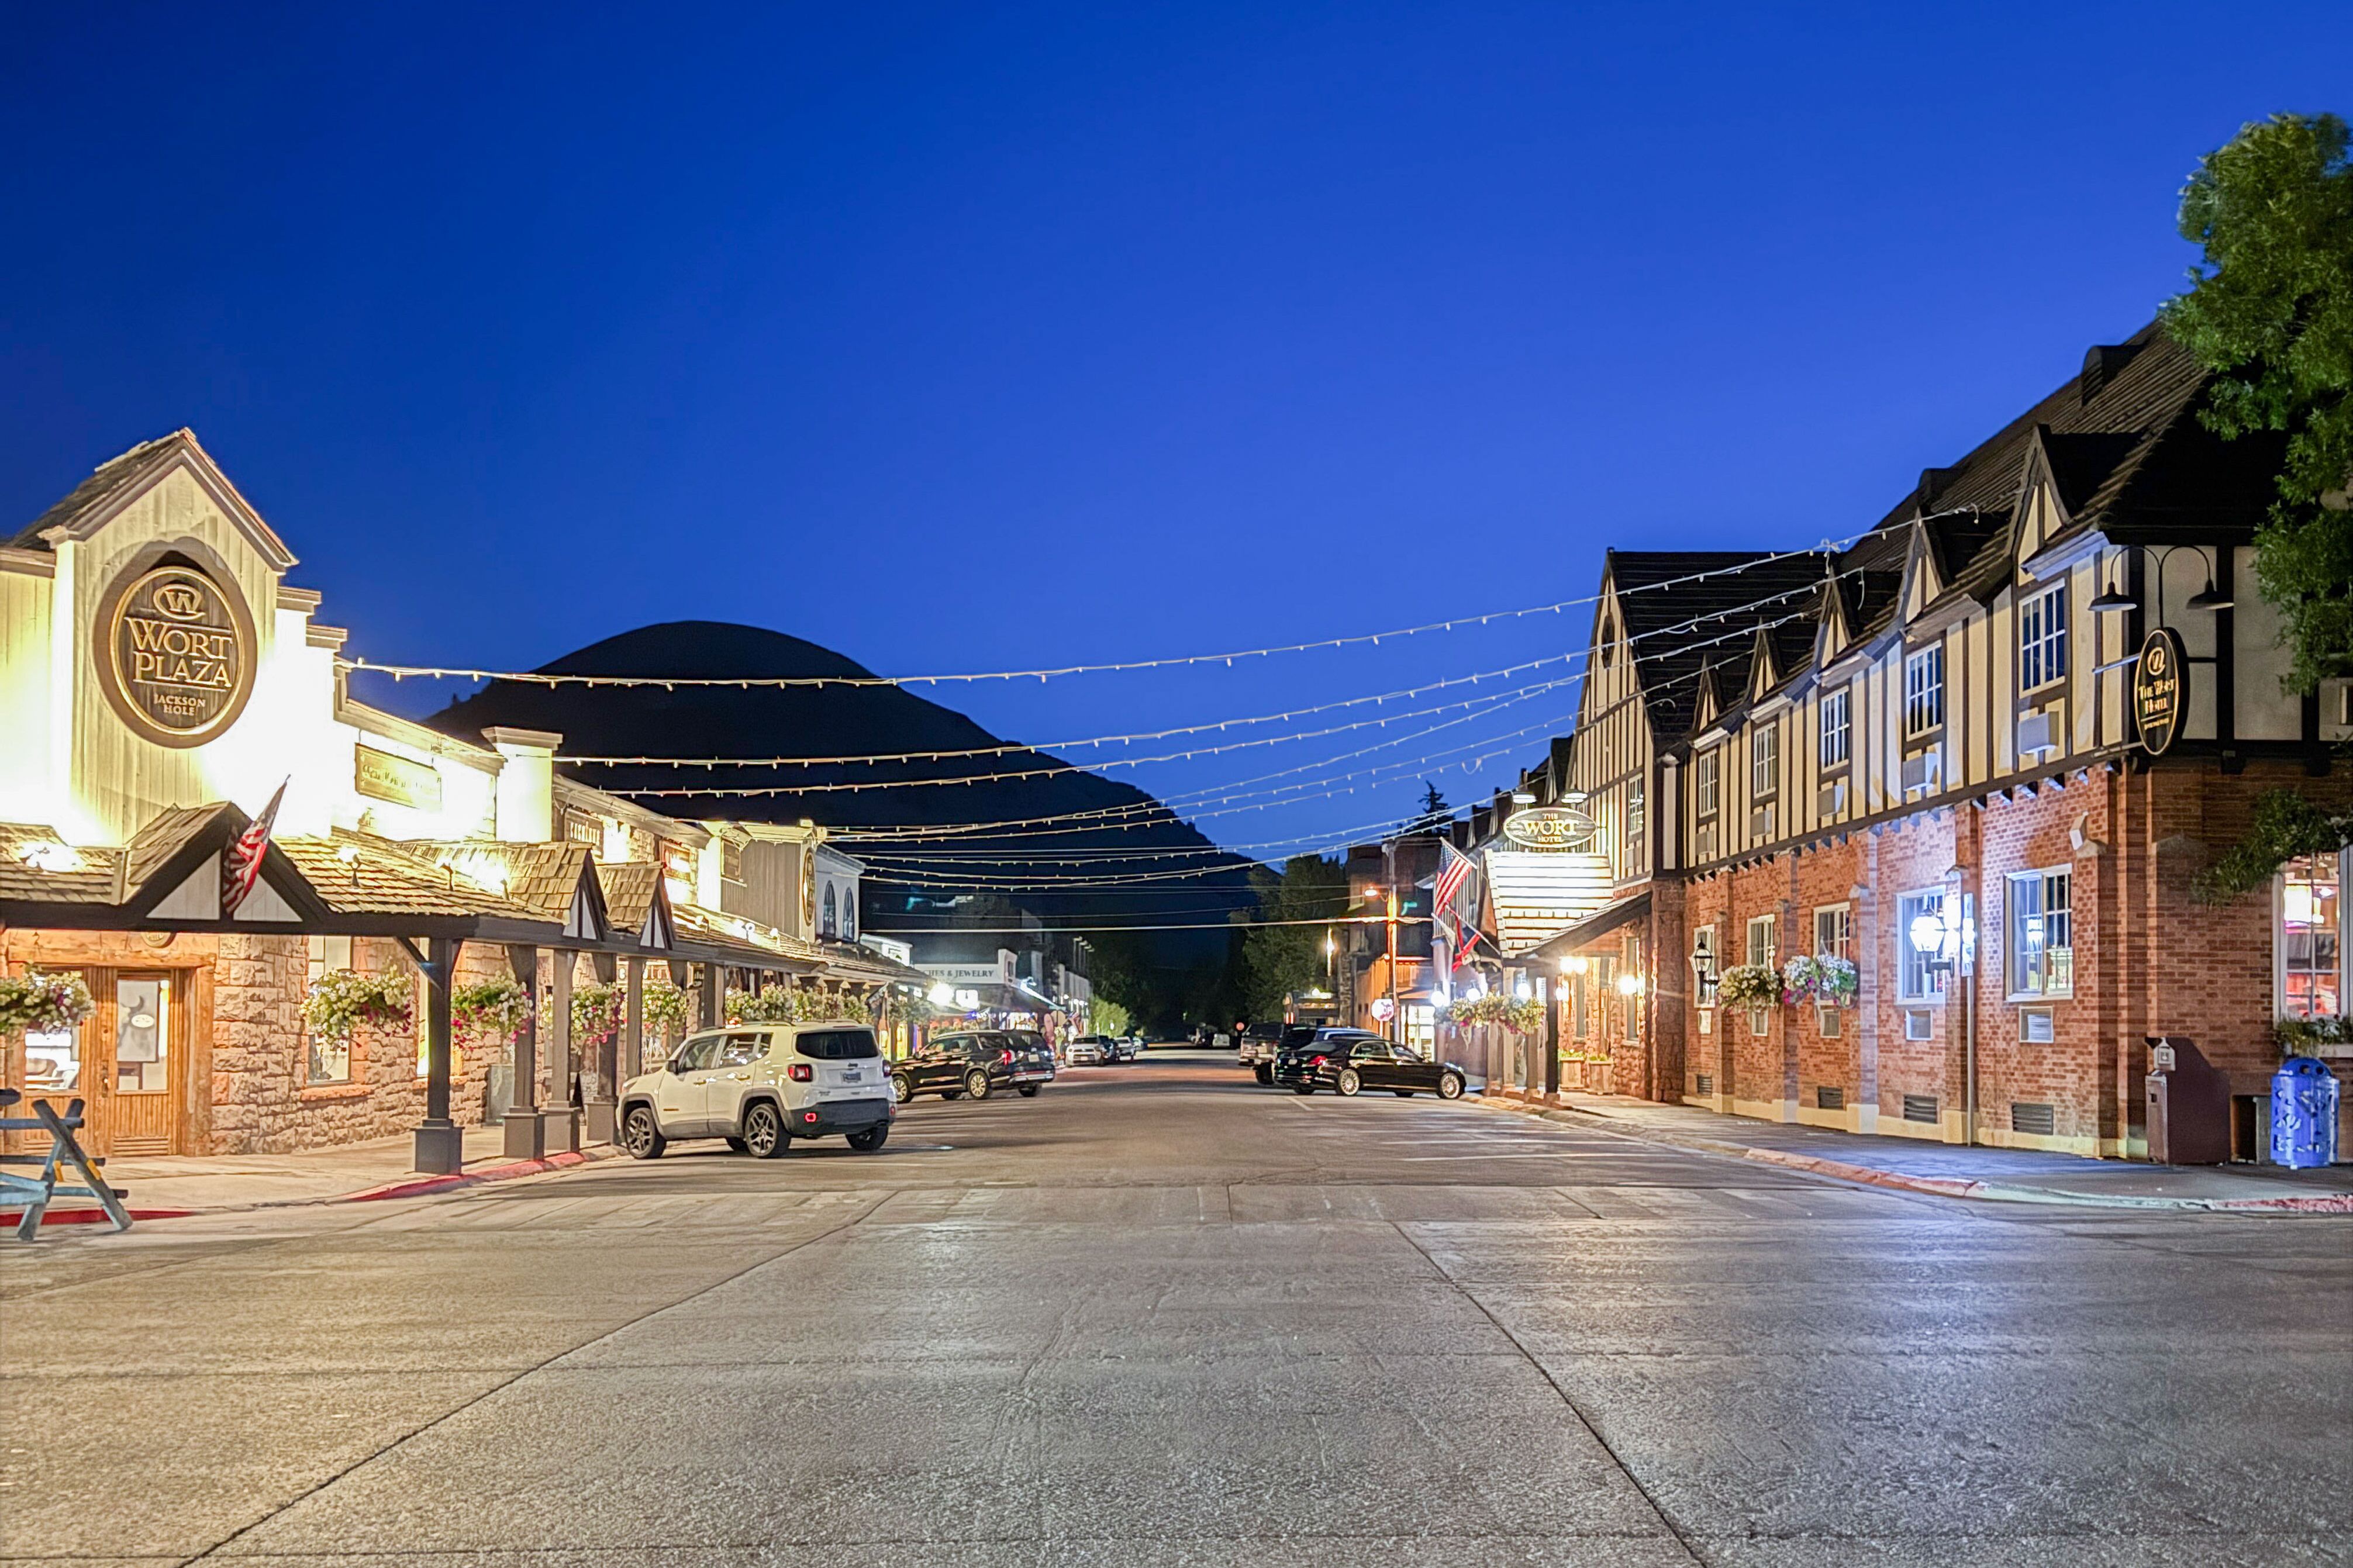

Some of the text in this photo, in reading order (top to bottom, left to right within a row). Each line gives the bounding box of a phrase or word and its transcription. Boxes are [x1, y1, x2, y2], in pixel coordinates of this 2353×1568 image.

[124, 616, 233, 659] WORT
[133, 651, 232, 688] PLAZA
[153, 692, 206, 708] JACKSON
[163, 704, 195, 716] HOLE
[1521, 818, 1579, 836] WORT
[954, 969, 994, 978] JEWELRY
